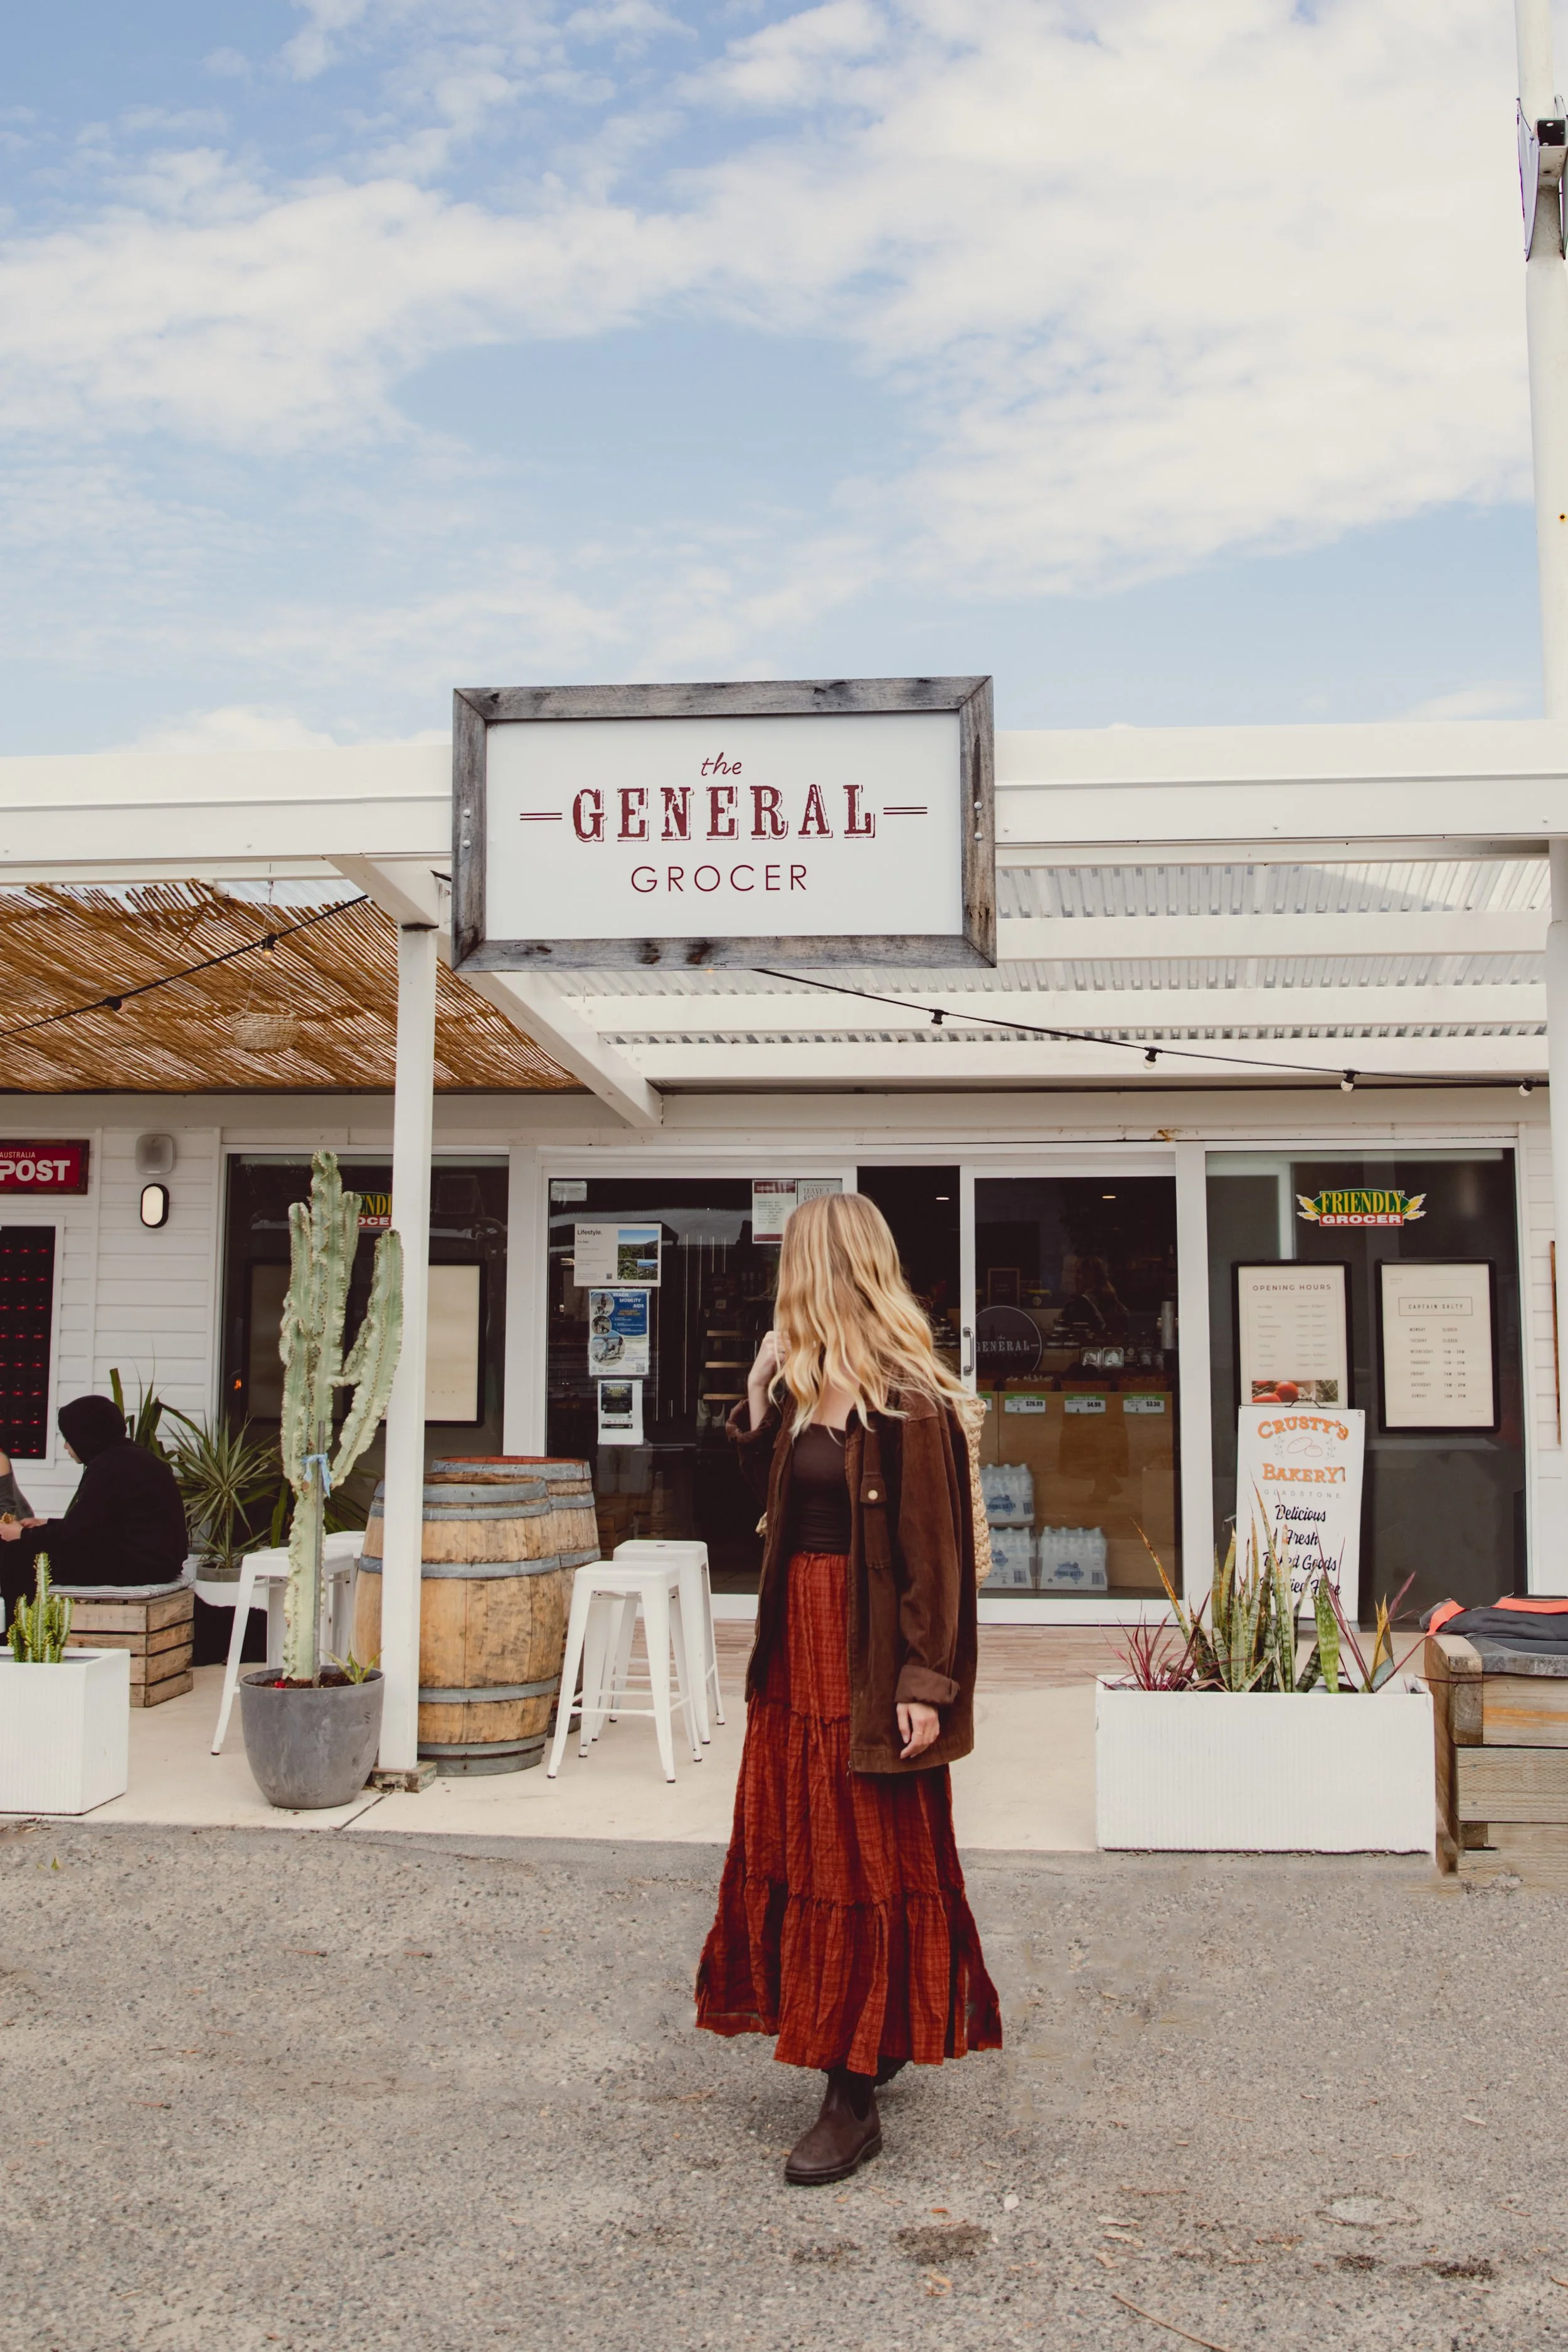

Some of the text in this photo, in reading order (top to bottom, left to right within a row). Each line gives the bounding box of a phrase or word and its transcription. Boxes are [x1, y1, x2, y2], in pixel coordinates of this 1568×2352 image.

[701, 751, 742, 776] the
[572, 783, 876, 843] GENERAL
[631, 864, 807, 893] GROCER
[0, 1159, 71, 1182] POST
[1322, 1191, 1404, 1213] FRIENDLY
[1322, 1214, 1401, 1224] GROCER
[1257, 1416, 1350, 1441] CRUSTY'S
[1264, 1489, 1340, 1499] GLADSTONE
[1274, 1504, 1327, 1522] Delicious
[1286, 1529, 1318, 1546] Fresh
[1302, 1554, 1337, 1571] Goods
